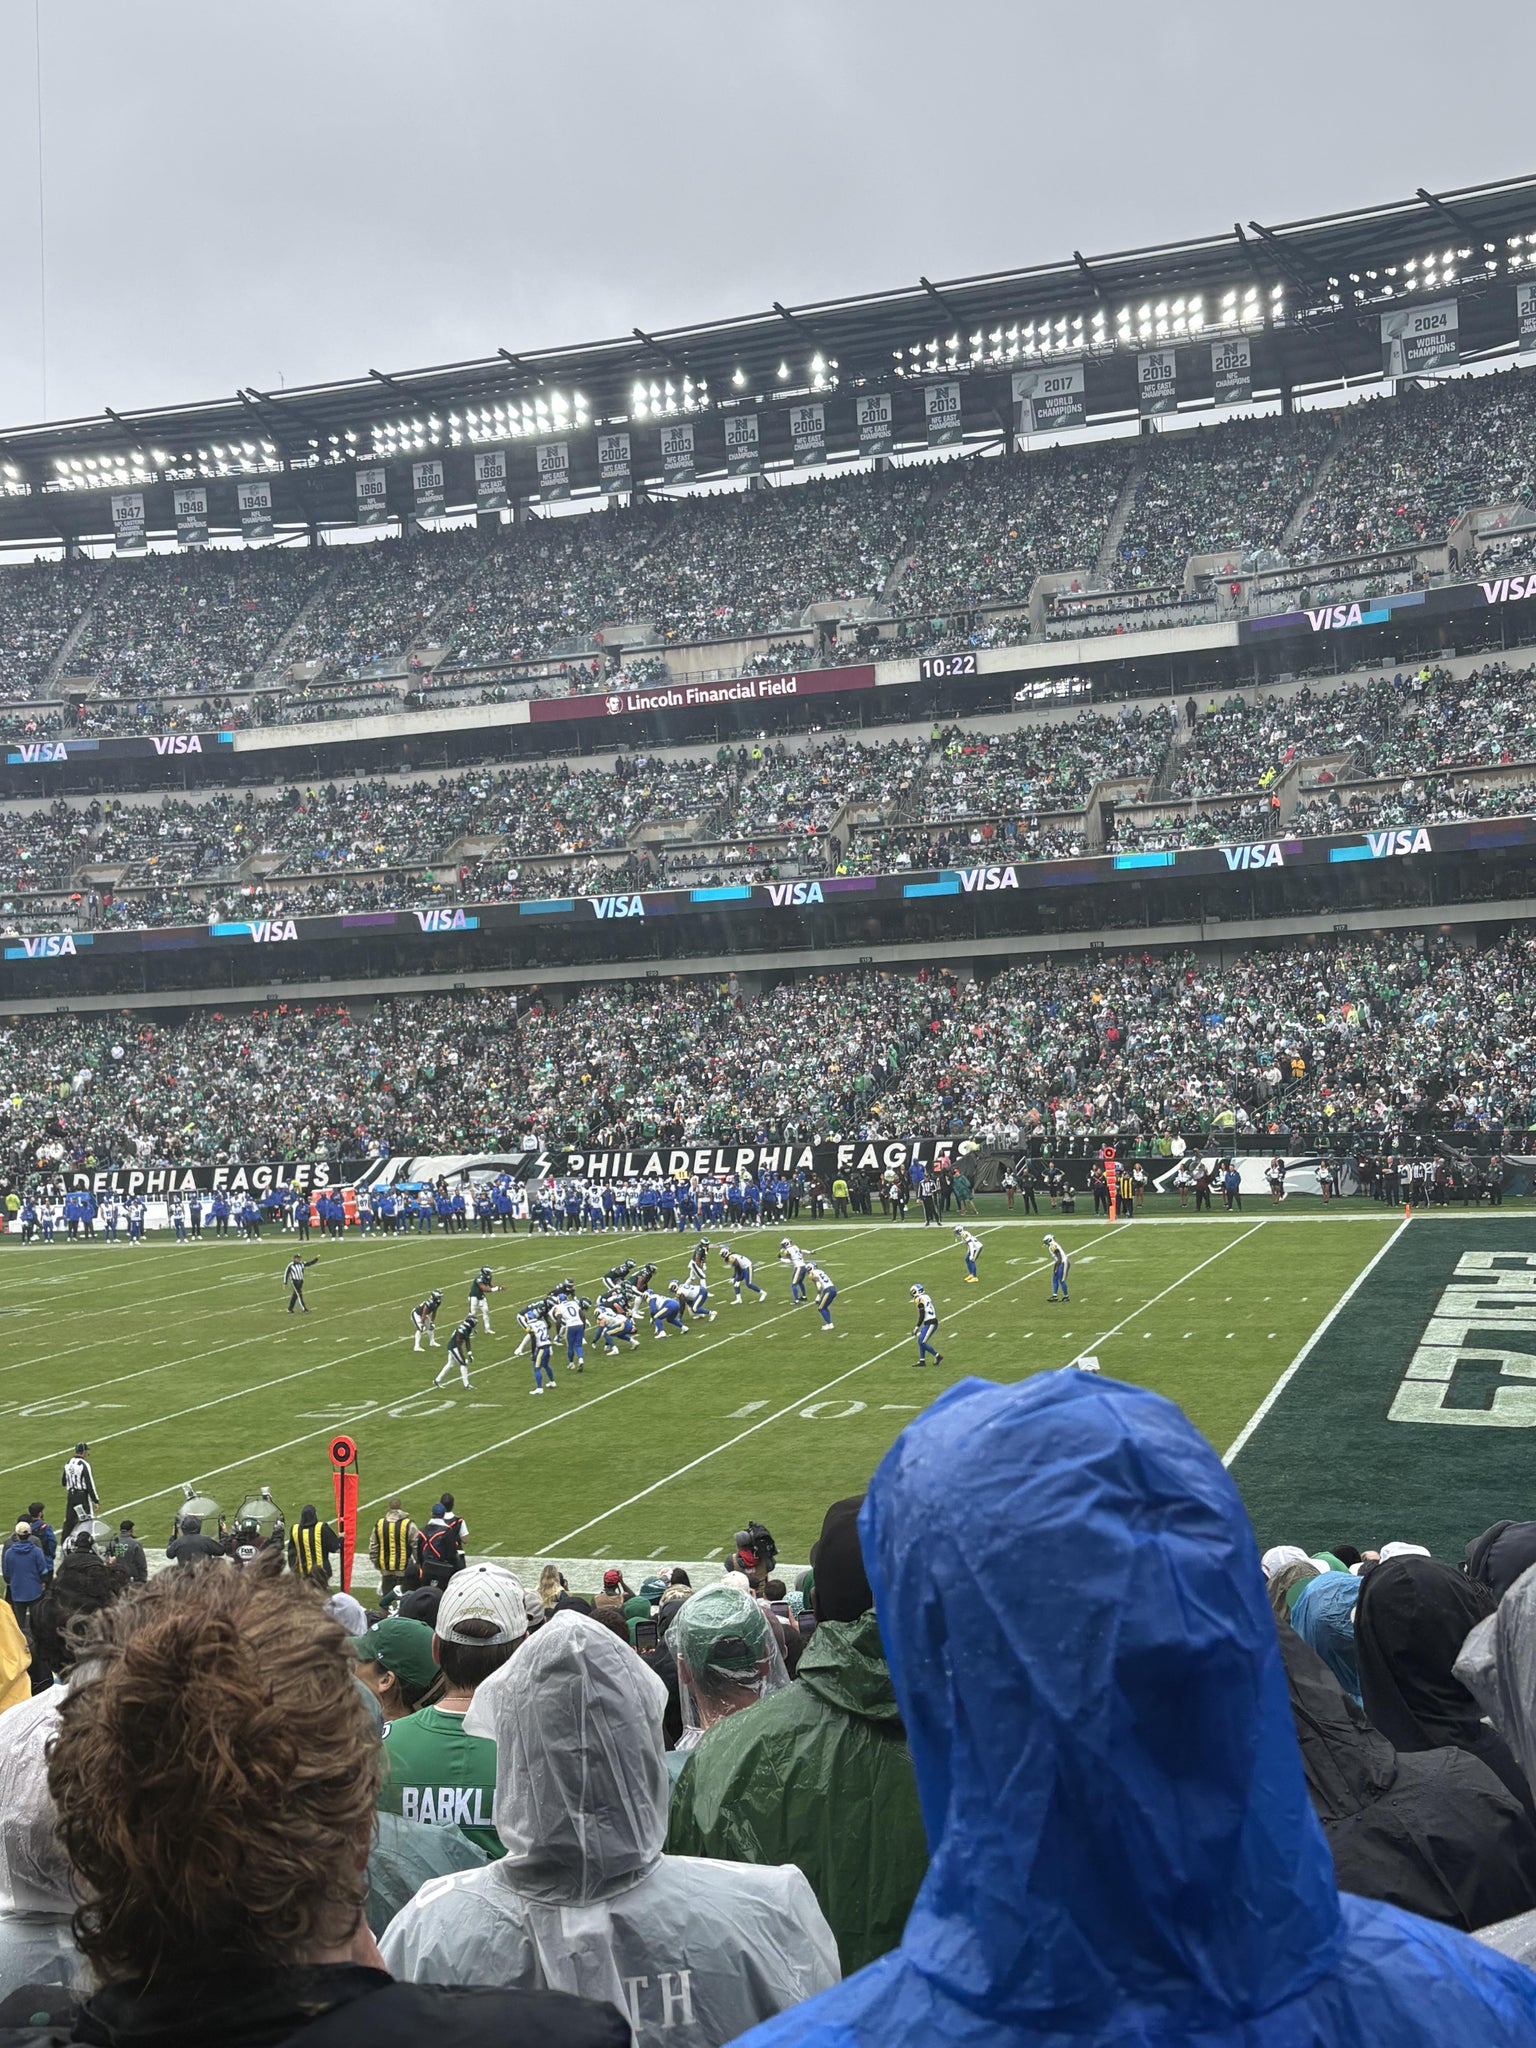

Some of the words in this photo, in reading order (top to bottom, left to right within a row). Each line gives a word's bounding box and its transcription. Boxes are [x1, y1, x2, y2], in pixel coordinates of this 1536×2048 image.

[1414, 314, 1447, 332] 2024
[1416, 335, 1446, 348] WORLD
[1408, 342, 1456, 360] CHAMPIONS
[1215, 354, 1248, 370] 2022
[1142, 366, 1172, 381] 2019
[1226, 372, 1238, 380] NFC
[1044, 376, 1073, 393] 2017
[1157, 382, 1172, 390] EAST
[1215, 377, 1250, 388] CHAMPIONS
[1141, 389, 1175, 399] CHAMPIONS
[930, 398, 957, 413] 2013
[1045, 396, 1073, 408] WORLD
[862, 409, 887, 423] 2010
[1037, 404, 1082, 418] CHAMPIONS
[929, 420, 961, 431] CHAMPIONS
[931, 416, 943, 424] NFC
[943, 414, 957, 422] EAST
[794, 419, 821, 434] 2006
[875, 424, 888, 432] EAST
[728, 429, 755, 444] 2004
[860, 430, 892, 441] CHAMPIONS
[664, 439, 691, 453] 2003
[794, 440, 825, 451] CHAMPIONS
[601, 447, 628, 461] 2002
[677, 454, 690, 462] EAST
[728, 451, 758, 461] CHAMPIONS
[541, 456, 565, 470] 2001
[664, 461, 694, 470] CHAMPIONS
[479, 465, 502, 479] 1988
[601, 470, 630, 479] CHAMPIONS
[360, 482, 382, 495] 1960
[417, 475, 440, 488] 1980
[540, 478, 569, 487] CHAMPIONS
[478, 487, 506, 495] CHAMPIONS
[242, 496, 268, 508] 1949
[416, 495, 444, 504] CHAMPIONS
[116, 507, 141, 519] 1947
[179, 501, 203, 513] 1948
[359, 503, 386, 511] CHAMPIONS
[178, 521, 207, 529] CHAMPIONS
[242, 516, 272, 524] CHAMPIONS
[1304, 604, 1363, 631] VISA
[922, 656, 975, 678] 10:22
[627, 690, 682, 711] Lincoln
[686, 683, 756, 704] Financial
[758, 677, 797, 696] Field
[150, 735, 202, 755] VISA
[16, 743, 68, 762] VISA
[1362, 829, 1432, 857] VISA
[1219, 843, 1284, 871] VISA
[955, 867, 1019, 892] VISA
[764, 882, 824, 906] VISA
[588, 896, 645, 919] VISA
[413, 909, 467, 931] VISA
[246, 921, 298, 942] VISA
[19, 936, 77, 957] VISA
[567, 1146, 814, 1178] PHILADELPHIA
[213, 1162, 330, 1191] EAGLES
[567, 1306, 576, 1317] 0
[622, 1969, 698, 2032] TH
